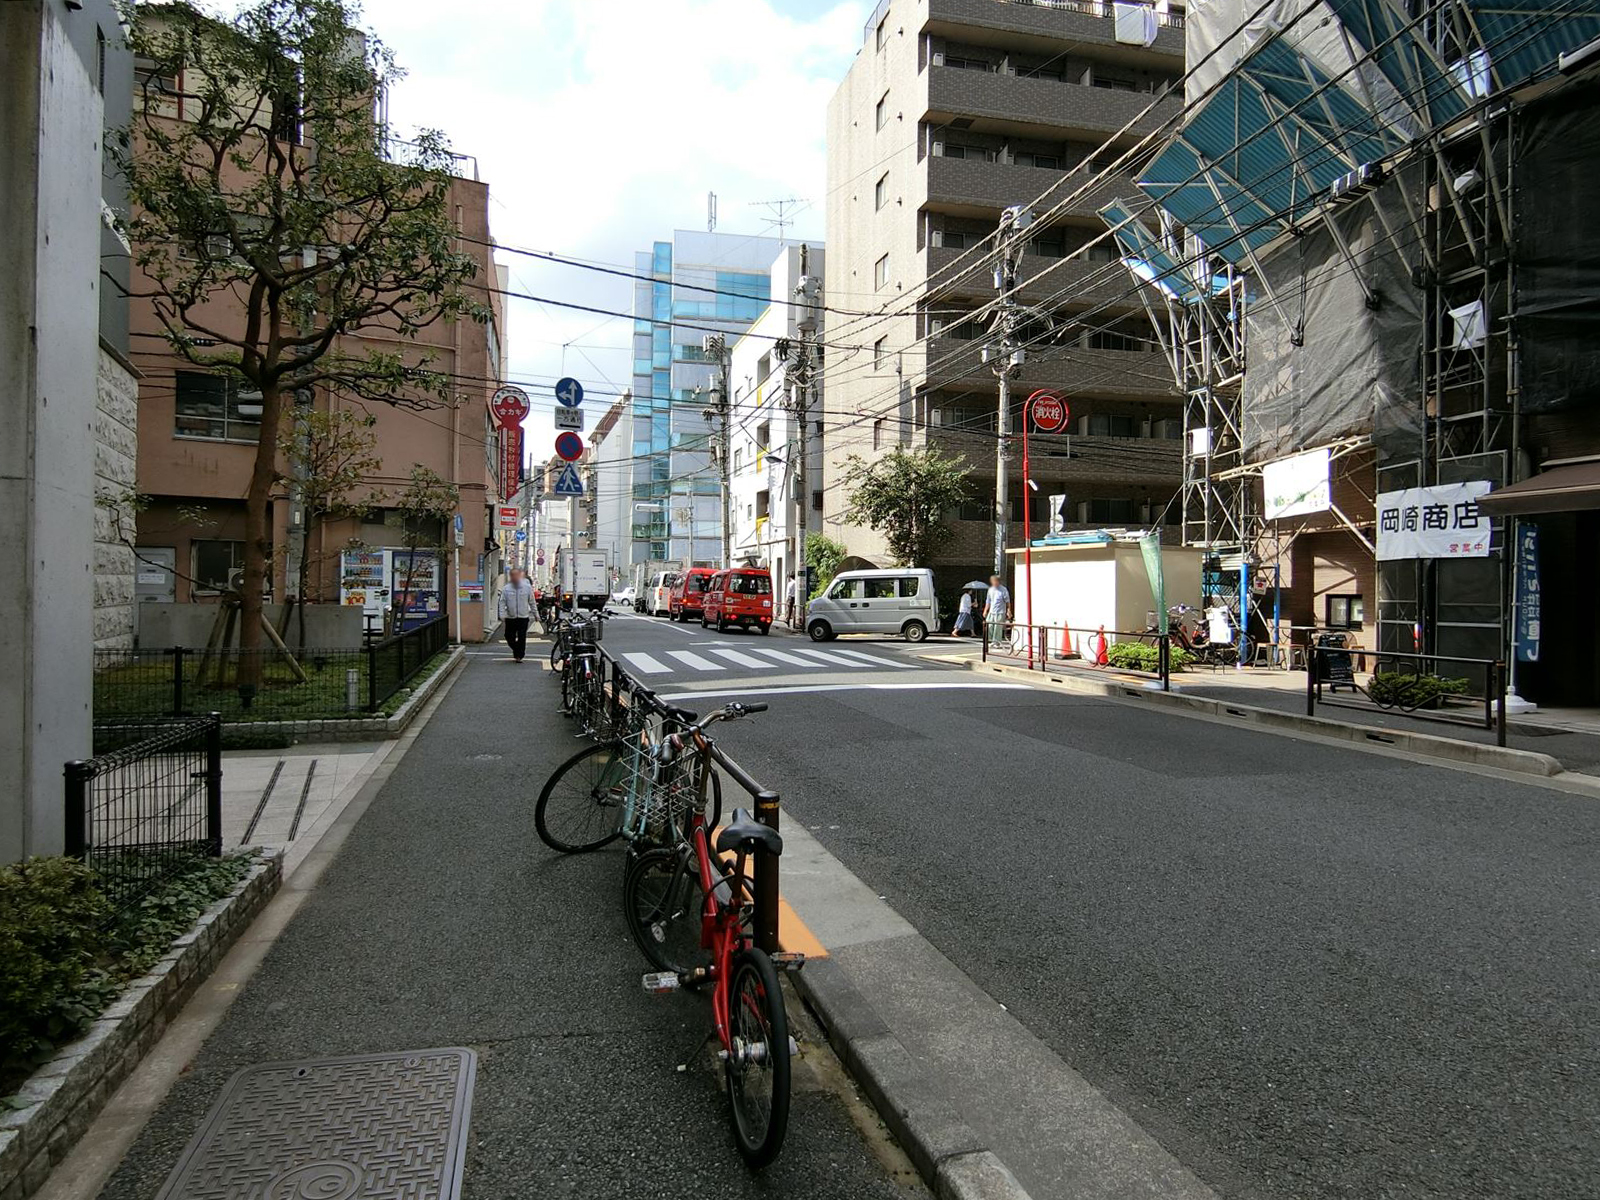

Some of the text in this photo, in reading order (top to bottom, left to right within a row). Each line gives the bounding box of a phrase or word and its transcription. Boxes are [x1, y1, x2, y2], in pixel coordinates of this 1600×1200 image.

[1035, 405, 1060, 419] 消火栓
[1381, 501, 1479, 534] 岡崎商店
[1449, 543, 1483, 553] 営業中
